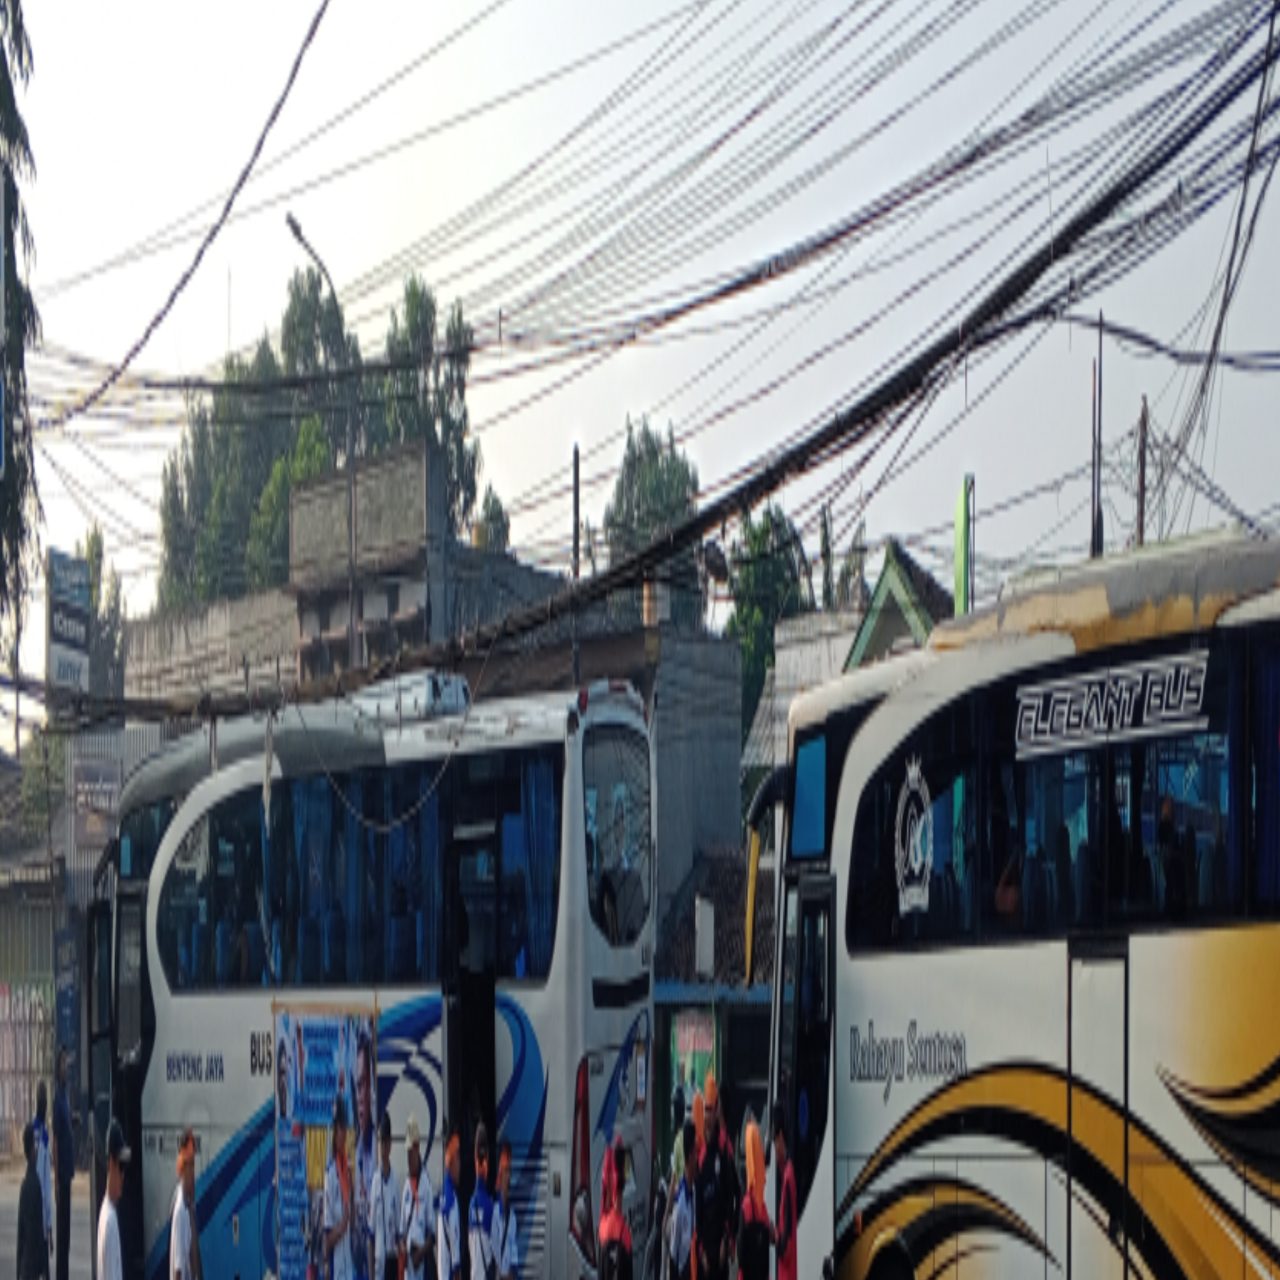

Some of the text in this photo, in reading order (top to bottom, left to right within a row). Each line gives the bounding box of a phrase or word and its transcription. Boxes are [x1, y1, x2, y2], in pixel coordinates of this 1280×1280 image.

[1144, 658, 1208, 725] BUS
[166, 1051, 224, 1083] BENTENG JAYA
[250, 1032, 272, 1075] BUS
[850, 1019, 966, 1106] Rahayu Sentosa
